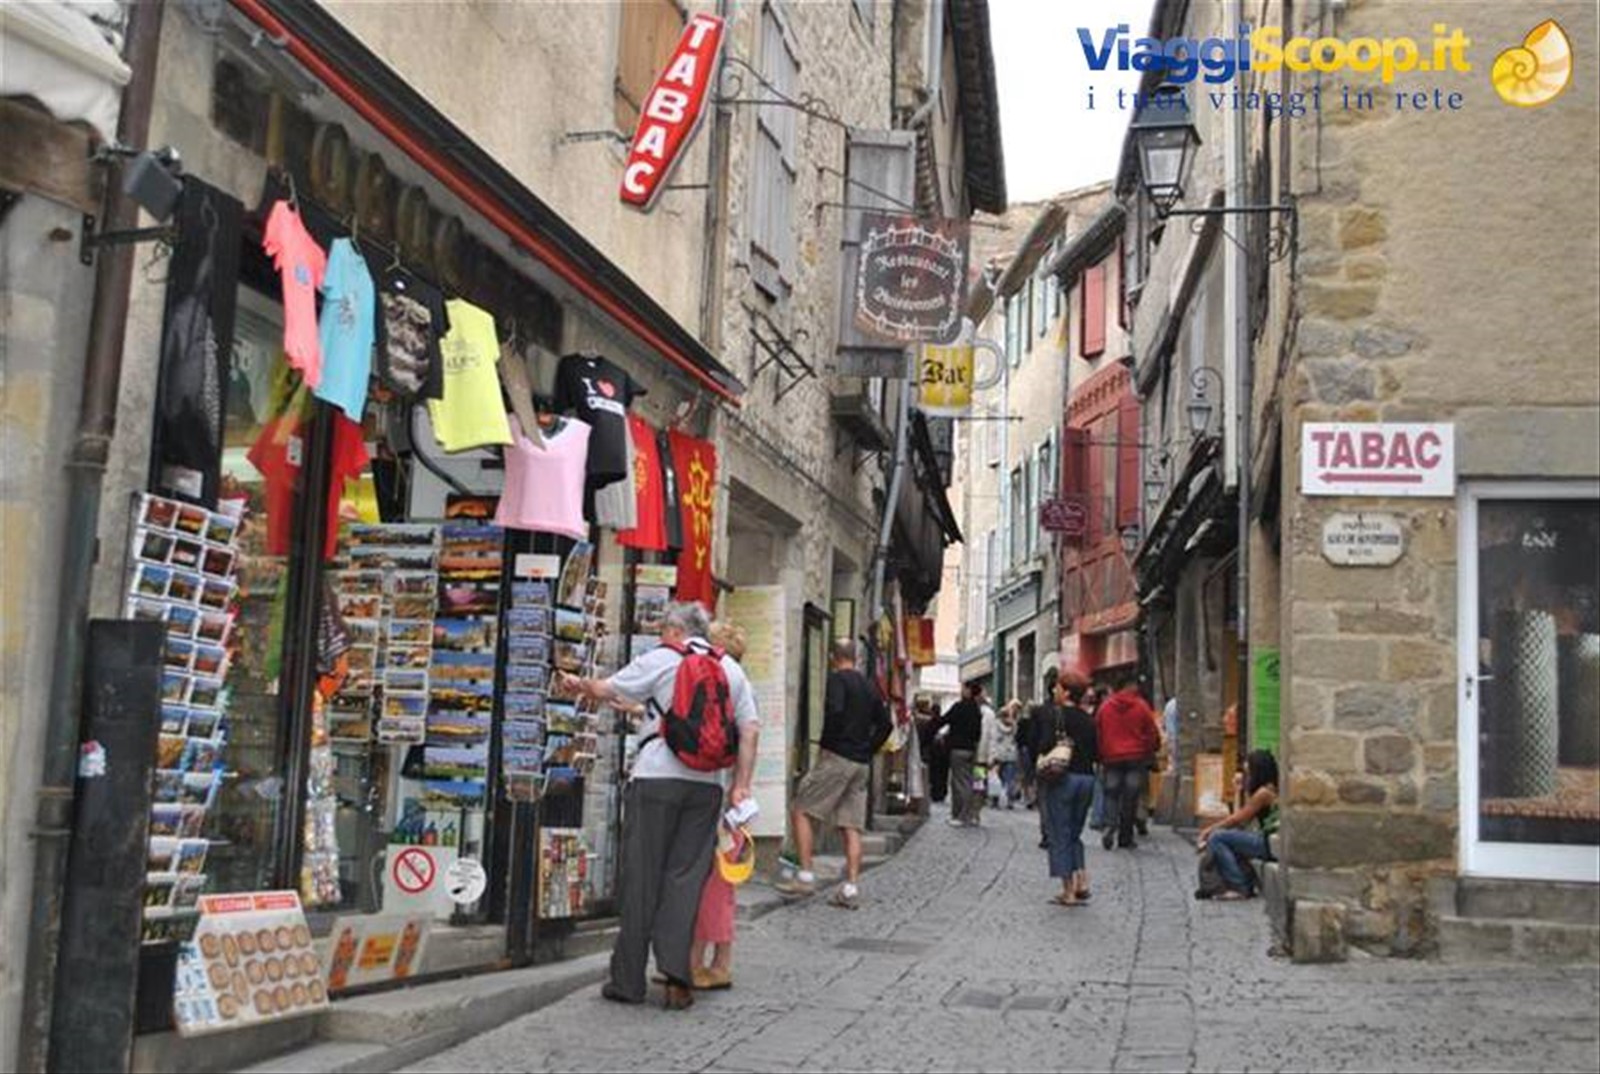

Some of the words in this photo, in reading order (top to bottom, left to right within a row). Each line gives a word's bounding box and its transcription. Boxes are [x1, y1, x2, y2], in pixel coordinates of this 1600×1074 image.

[624, 18, 717, 194] TABAC
[921, 359, 968, 385] Bar
[1311, 431, 1442, 469] TABAC
